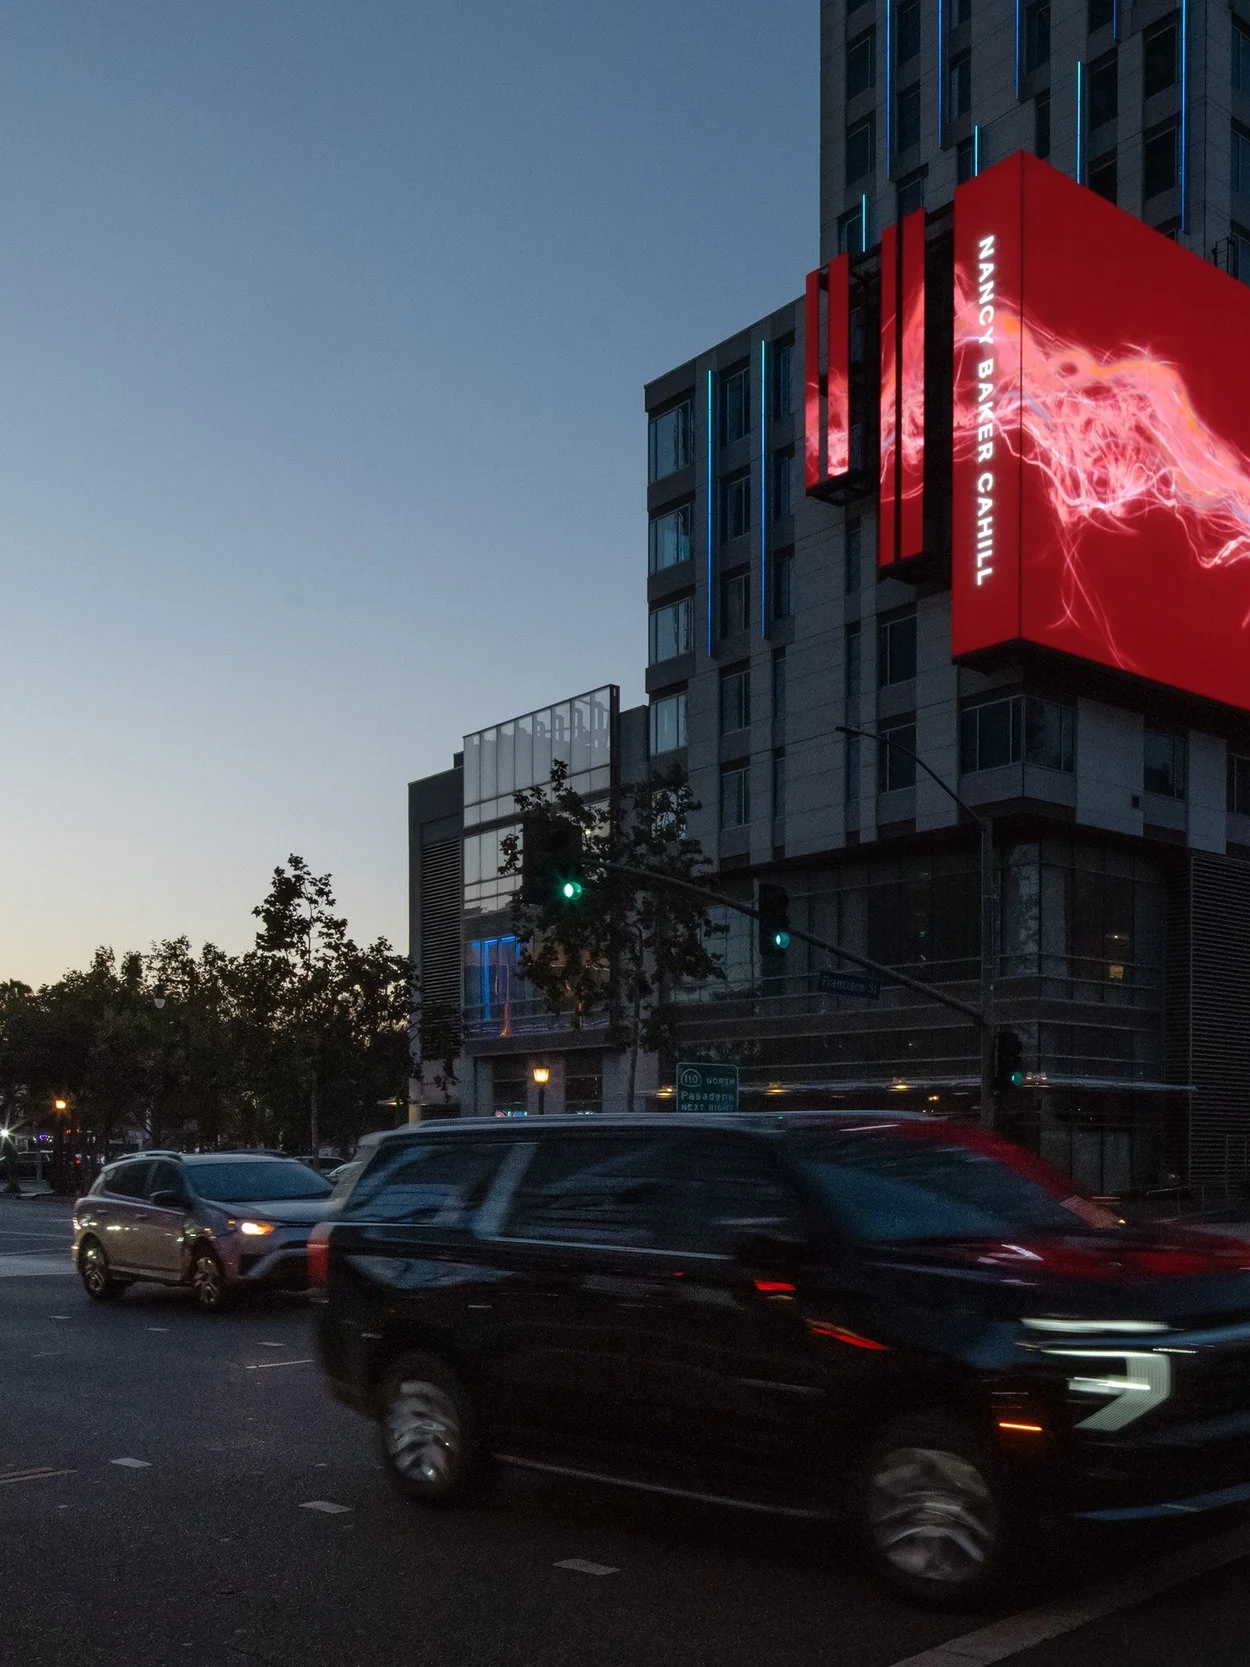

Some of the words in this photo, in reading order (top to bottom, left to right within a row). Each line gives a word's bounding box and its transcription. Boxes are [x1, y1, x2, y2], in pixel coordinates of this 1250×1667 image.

[977, 234, 996, 345] NANCY
[977, 359, 995, 463] BAKER
[976, 472, 995, 587] CAHILL
[681, 1091, 734, 1101] Pasadena
[681, 1103, 705, 1111] NEXT
[706, 1077, 735, 1085] NORTH
